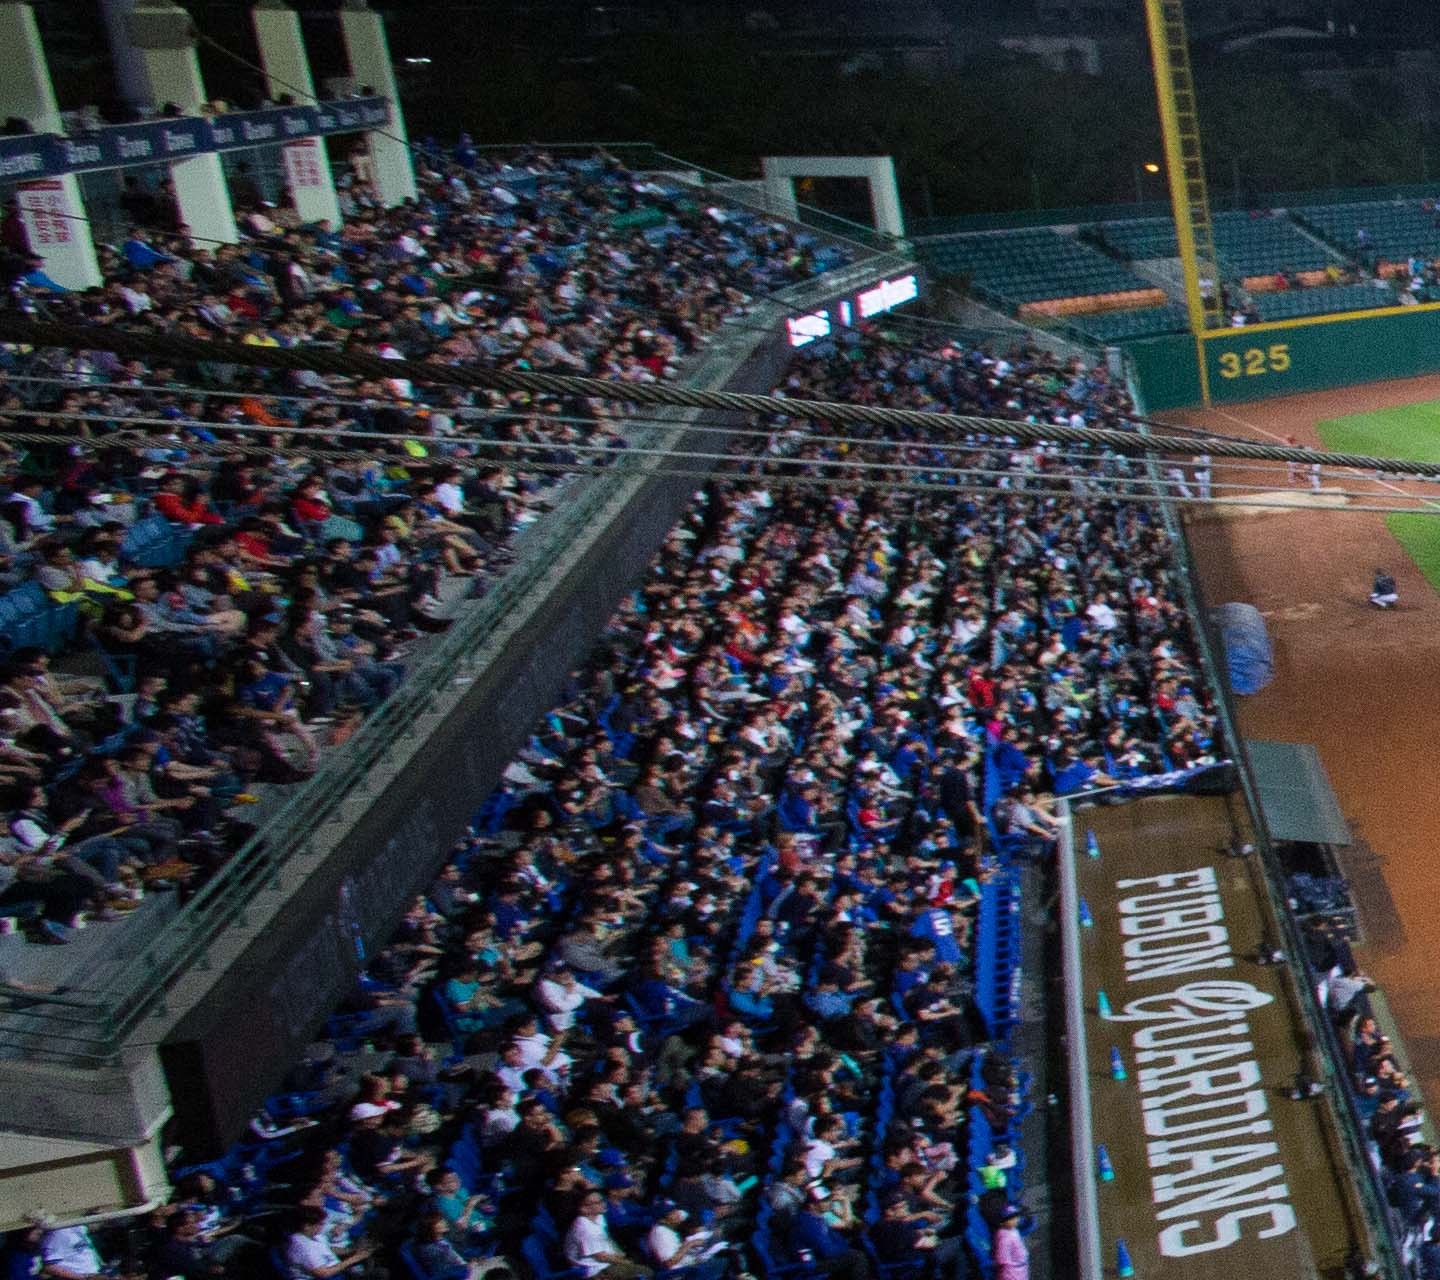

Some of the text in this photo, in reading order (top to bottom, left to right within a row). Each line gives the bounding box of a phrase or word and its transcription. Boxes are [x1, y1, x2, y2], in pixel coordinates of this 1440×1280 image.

[1218, 344, 1291, 378] 325
[1100, 867, 1298, 1257] FUBON GUARDIANS
